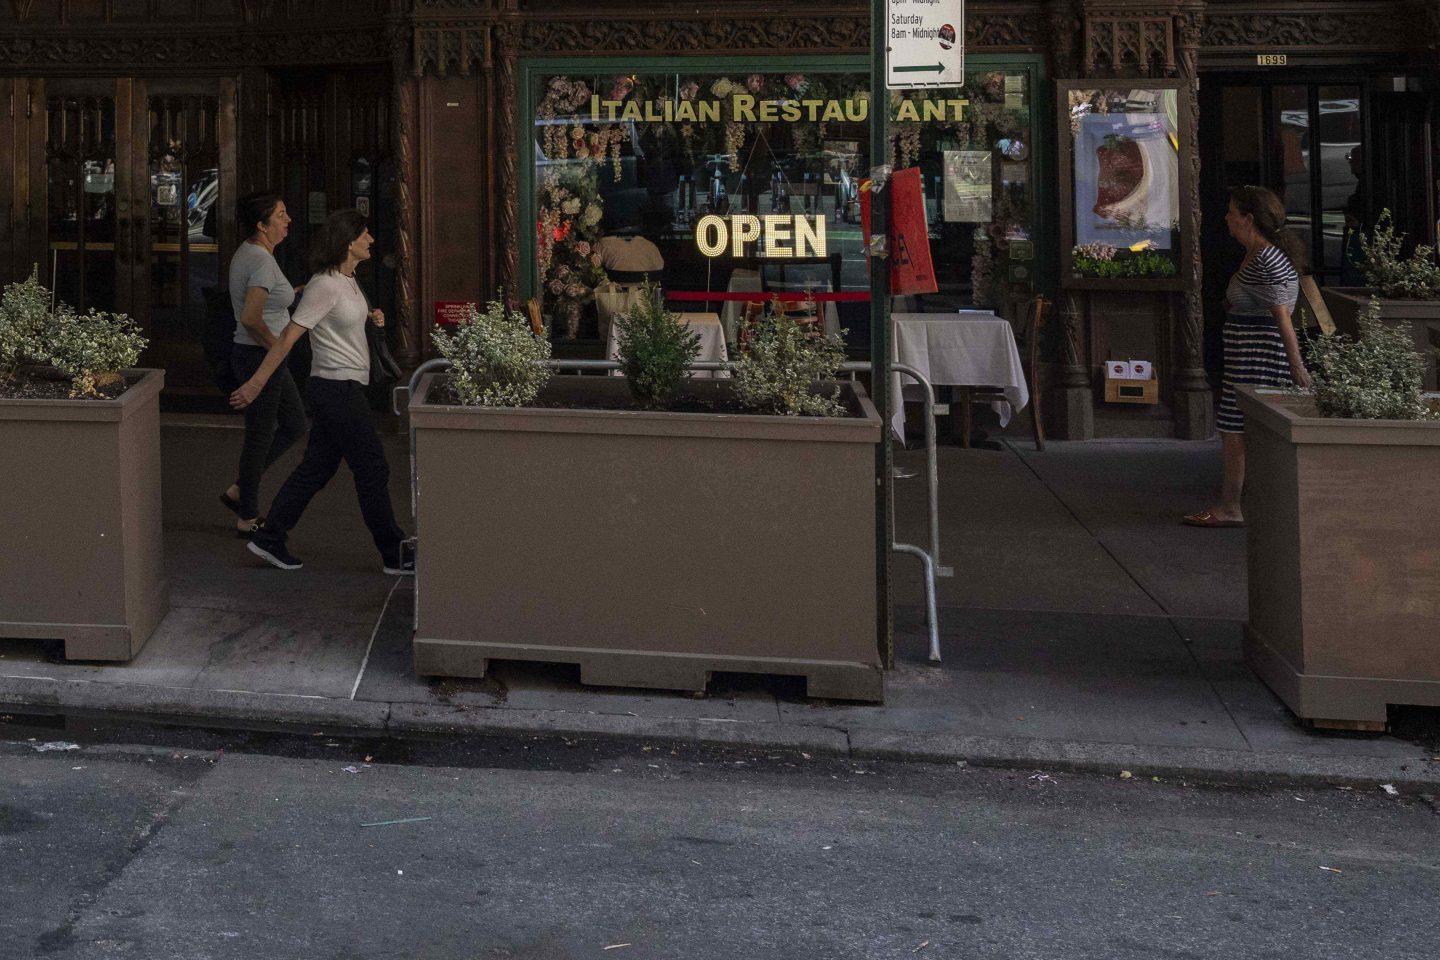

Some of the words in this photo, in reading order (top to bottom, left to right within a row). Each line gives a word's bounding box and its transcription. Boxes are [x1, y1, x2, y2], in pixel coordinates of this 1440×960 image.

[891, 13, 923, 26] Saturday
[891, 28, 907, 39] 8am
[912, 27, 941, 40] Midnight
[1260, 55, 1286, 65] 1699
[591, 94, 721, 122] ITALIAN
[732, 93, 970, 122] RESTAUANT
[696, 214, 827, 258] OPEN
